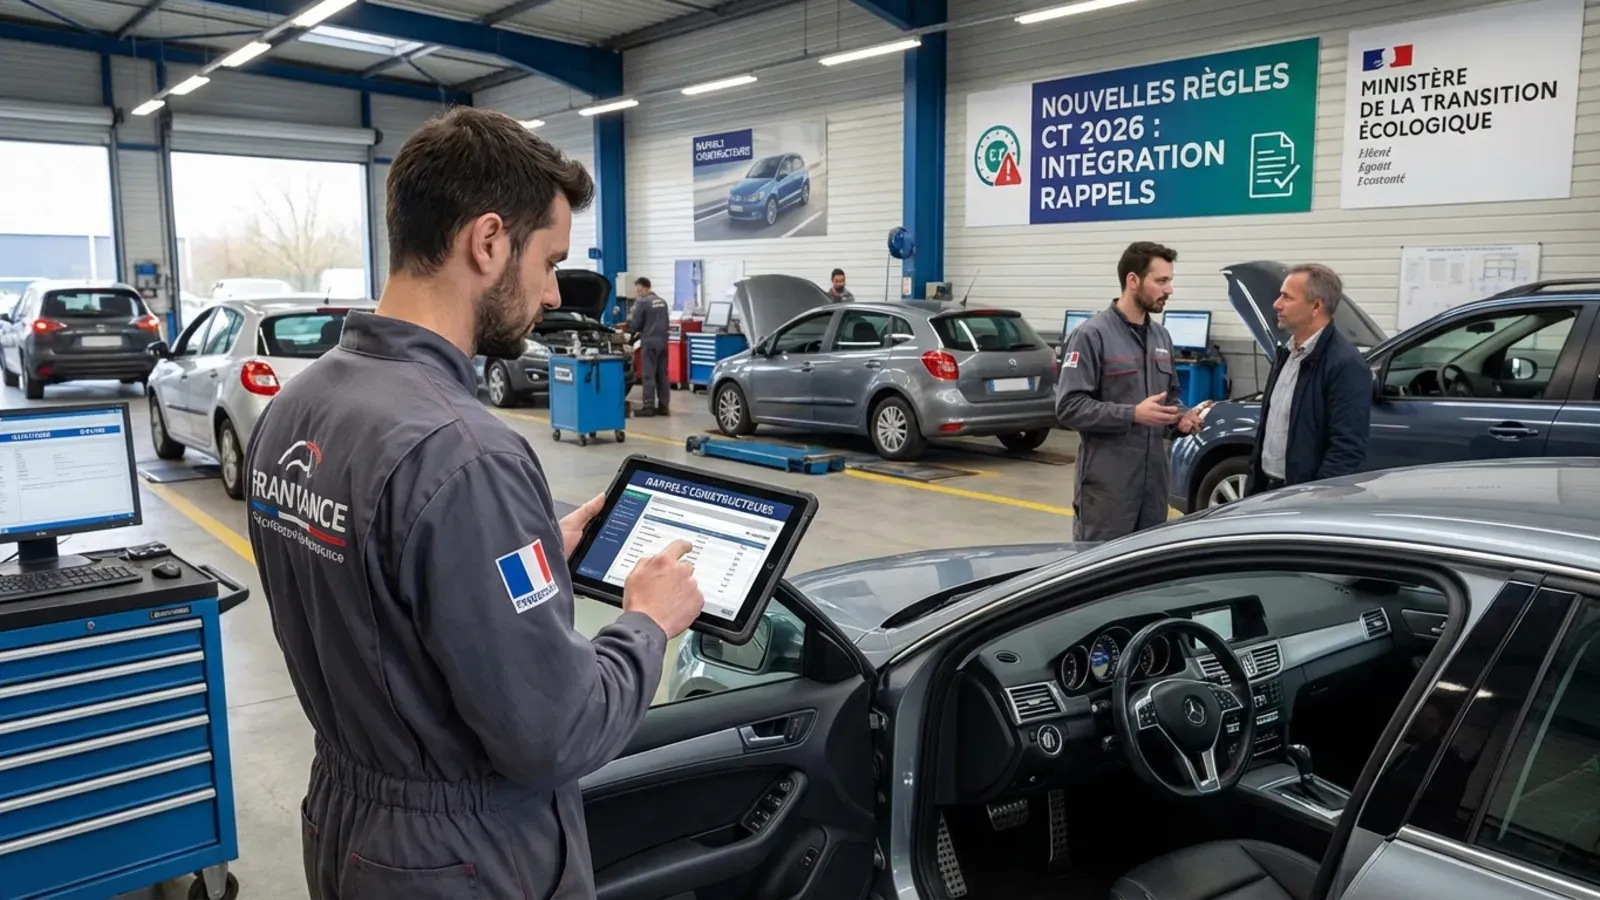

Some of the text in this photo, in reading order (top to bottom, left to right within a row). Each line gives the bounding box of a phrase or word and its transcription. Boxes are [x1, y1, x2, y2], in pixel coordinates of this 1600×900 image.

[1042, 62, 1290, 119] NOUVELLES RÈGLES
[1360, 80, 1558, 118] DE LA TRANSITION
[1361, 67, 1468, 97] MINISTÈRE
[1041, 115, 1160, 149] CT 2026 :
[1359, 111, 1492, 140] ÉCOLOGIQUE
[1041, 139, 1225, 179] INTÉGRATION
[1040, 179, 1156, 210] RAPPELS
